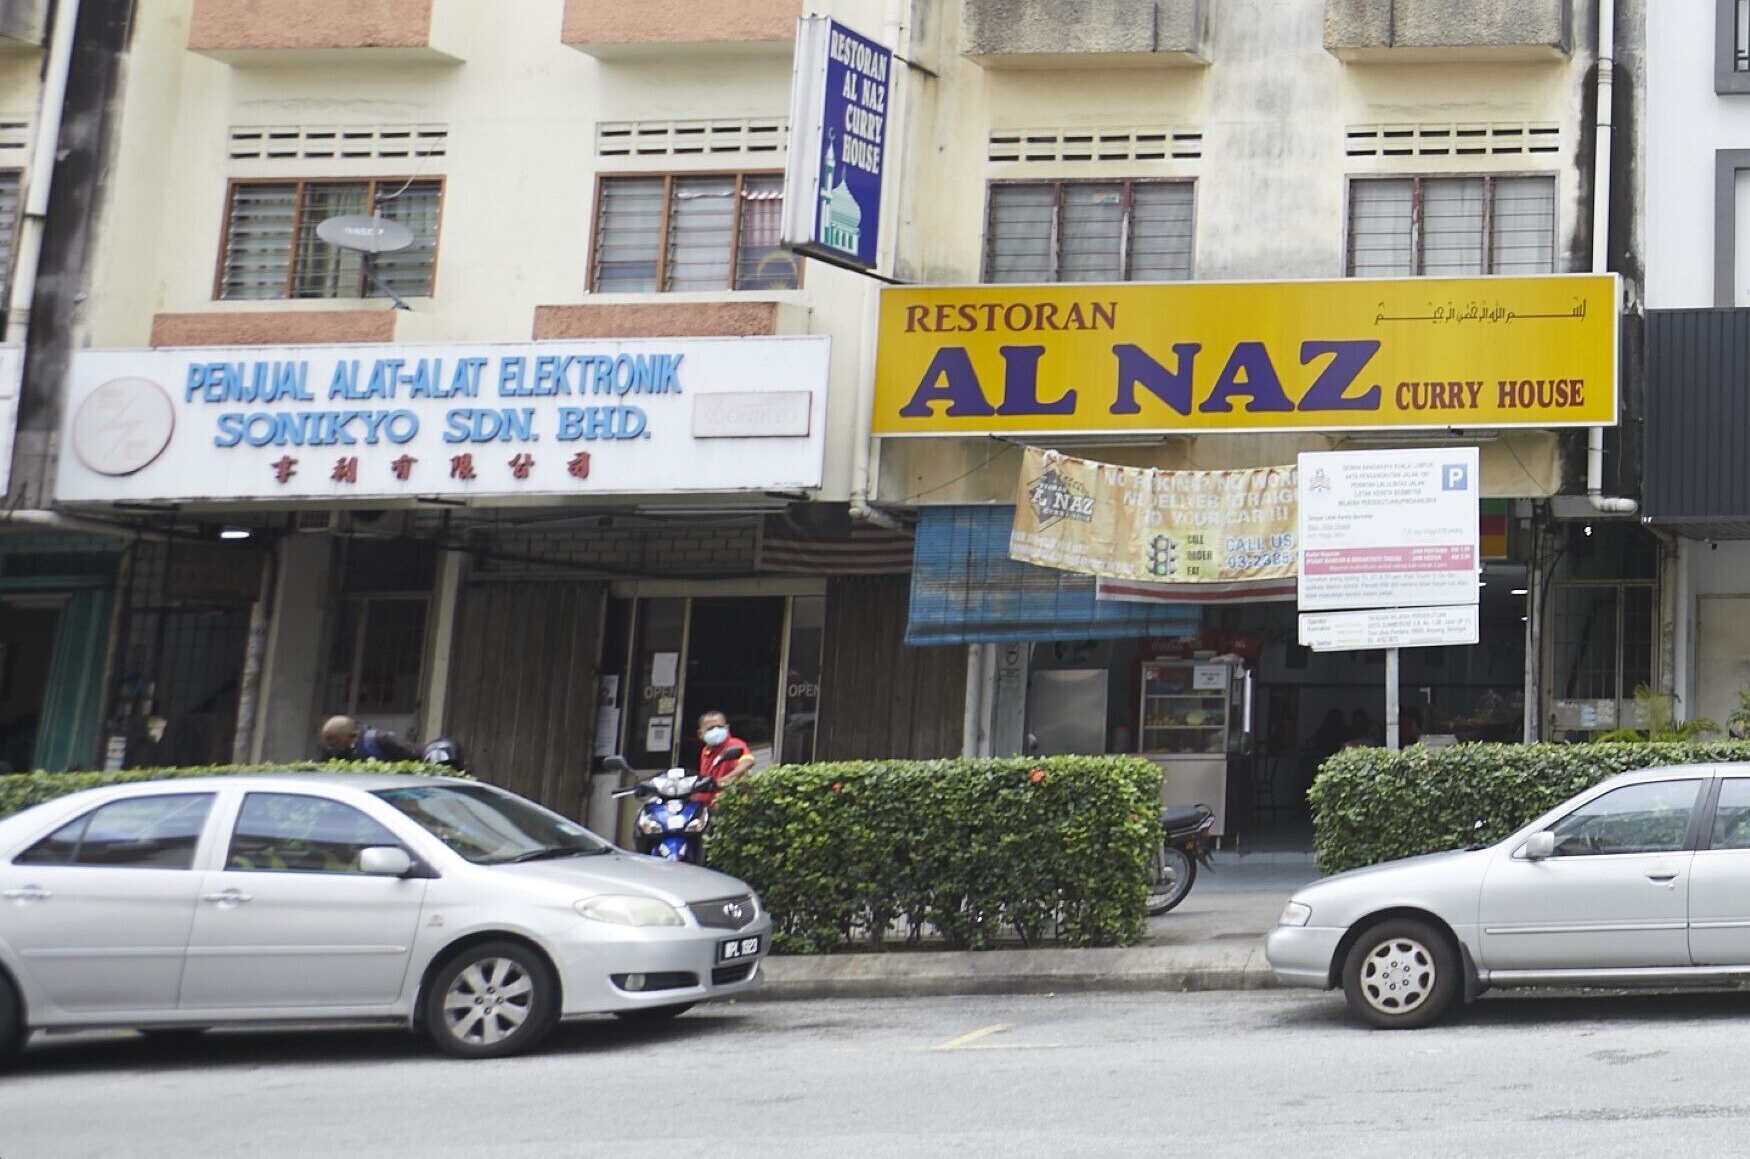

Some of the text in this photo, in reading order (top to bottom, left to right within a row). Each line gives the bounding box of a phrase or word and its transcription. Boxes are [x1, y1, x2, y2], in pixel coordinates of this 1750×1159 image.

[830, 29, 888, 82] RESTORAN
[842, 70, 885, 112] AL NAZ
[844, 103, 883, 144] CURRY
[842, 133, 880, 175] HOUSE
[904, 301, 1119, 333] RESTORAN
[184, 352, 685, 403] PENJUAL ALAT-ALAT ELEKTRONIK
[899, 339, 1382, 417] AL NAZ
[1395, 378, 1585, 411] CURRY HOUSE
[214, 405, 652, 448] SONIKYO SDN. BHD.
[1270, 533, 1292, 548] US
